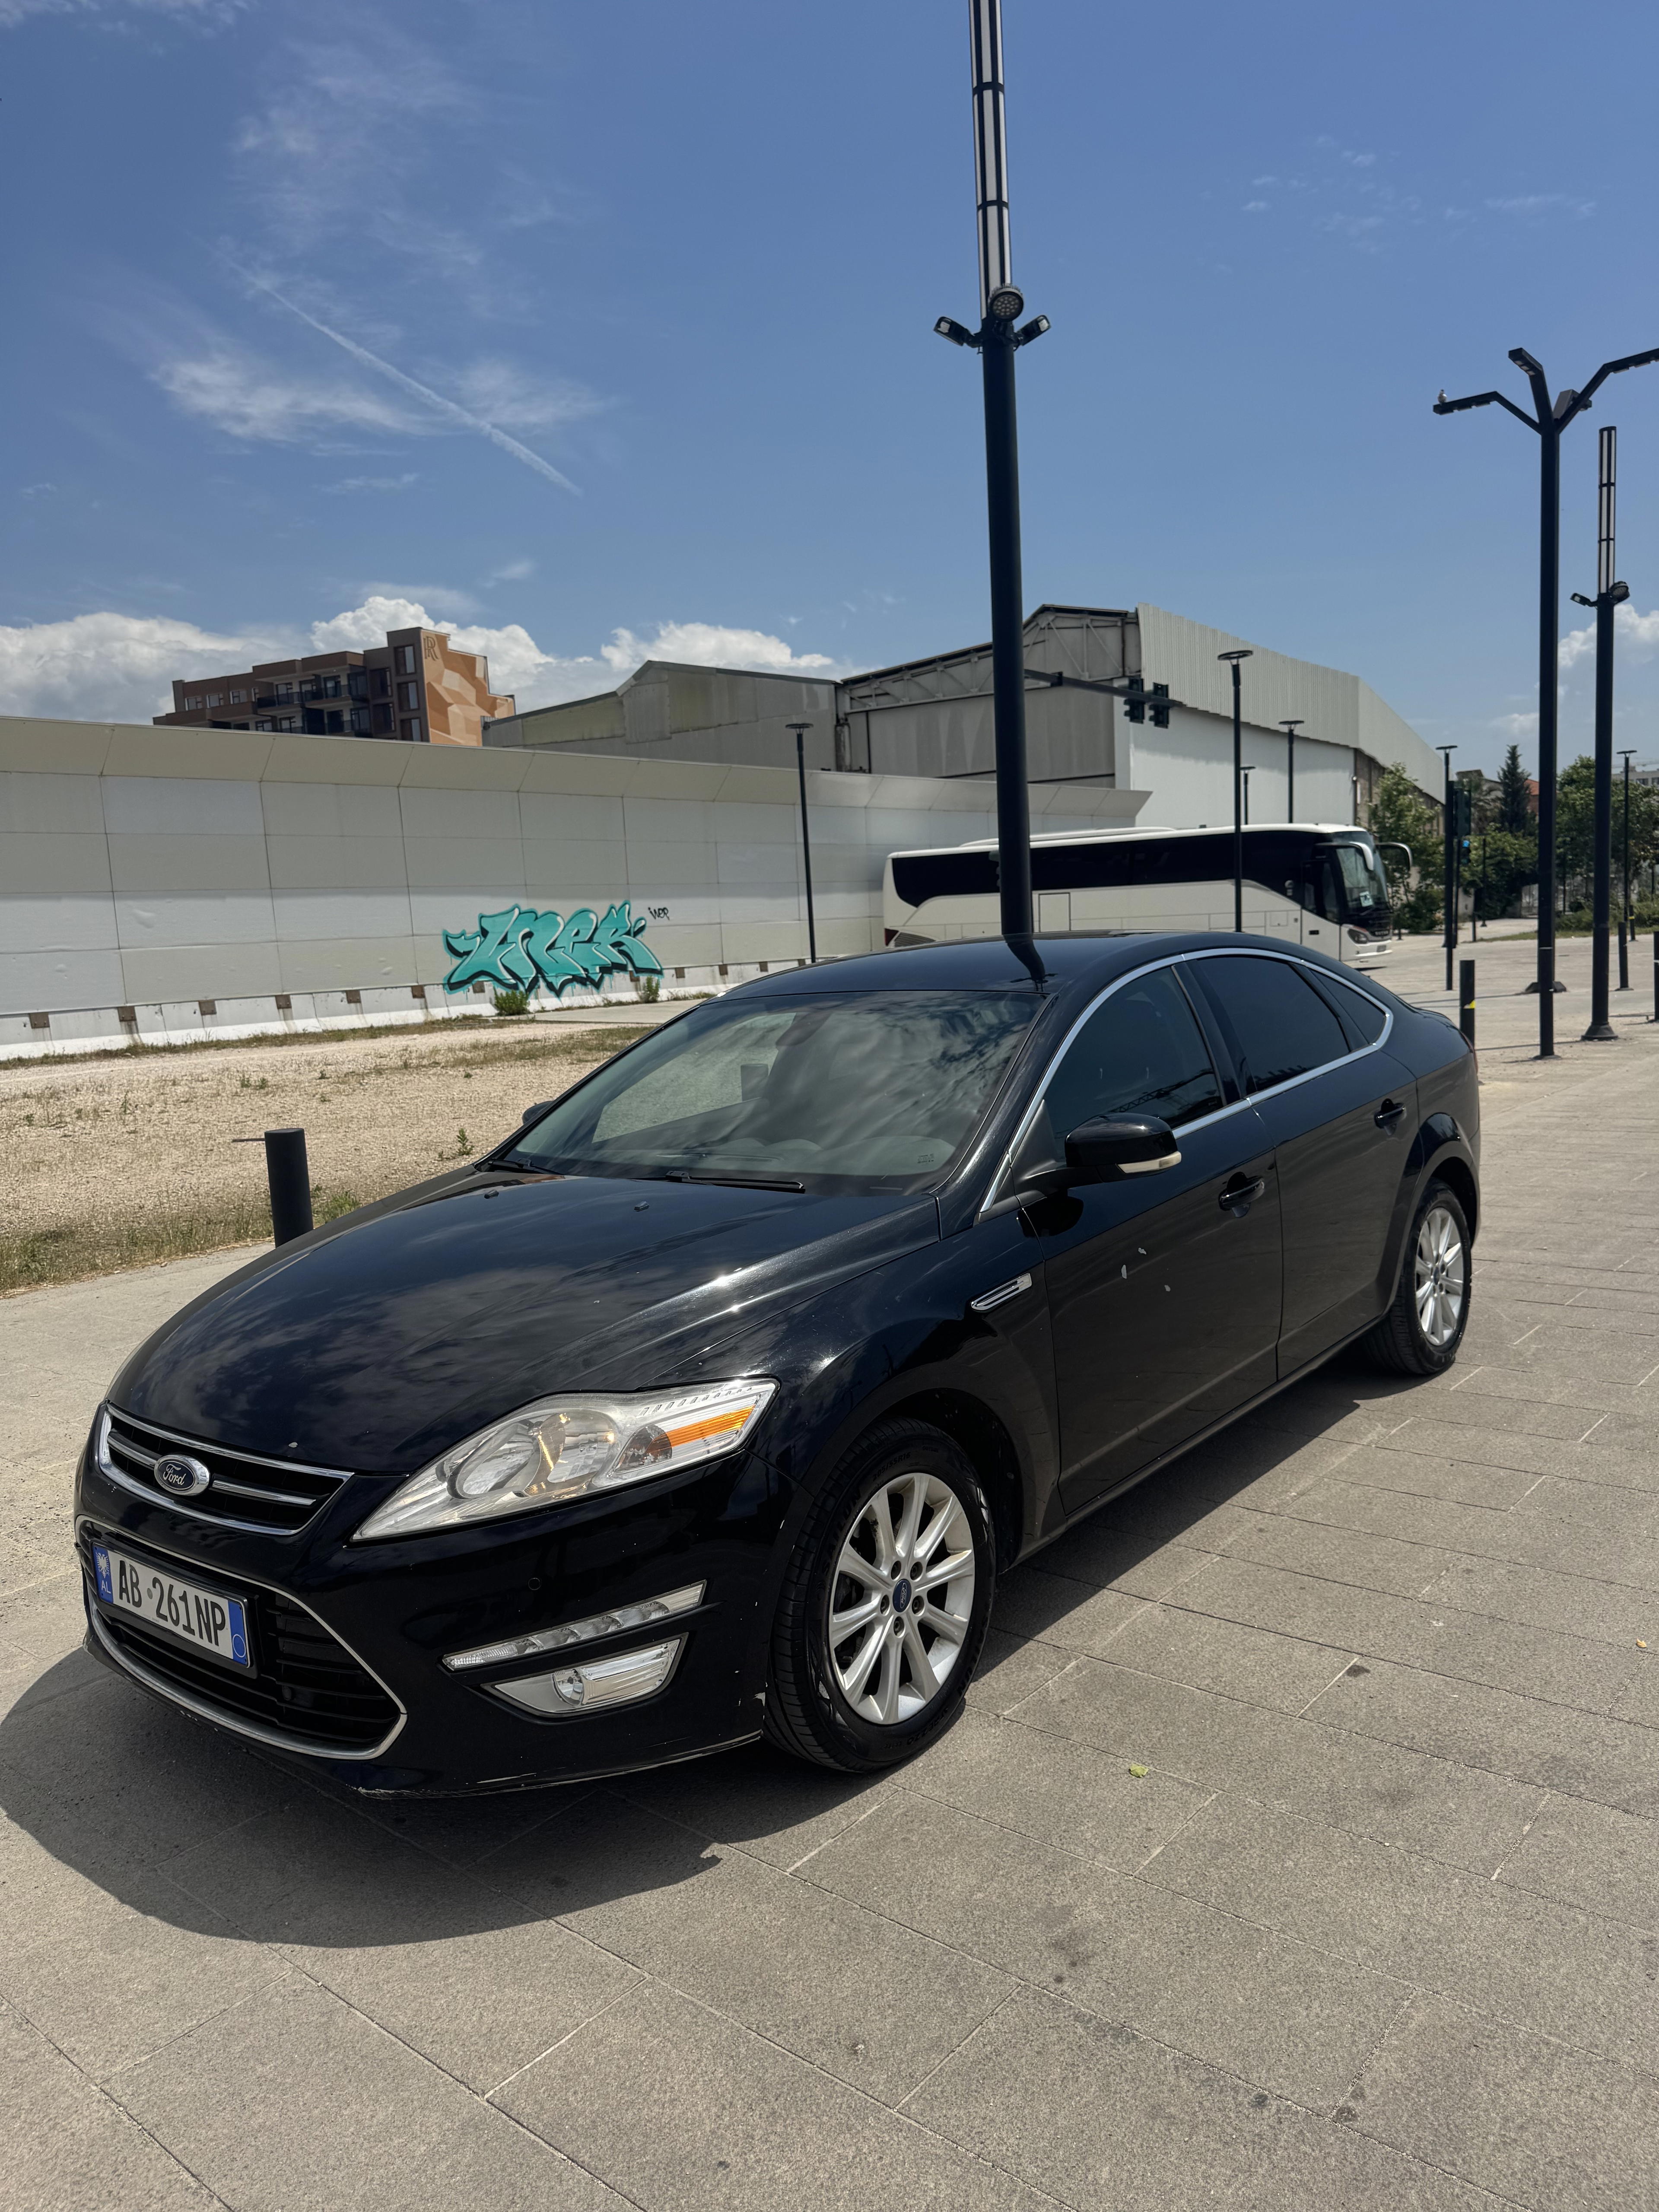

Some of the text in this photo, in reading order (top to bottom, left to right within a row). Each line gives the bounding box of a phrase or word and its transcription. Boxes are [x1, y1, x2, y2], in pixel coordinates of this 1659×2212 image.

[163, 1464, 187, 1485] Ford
[101, 1580, 111, 1594] AL
[119, 1560, 226, 1646] AB 261NP
